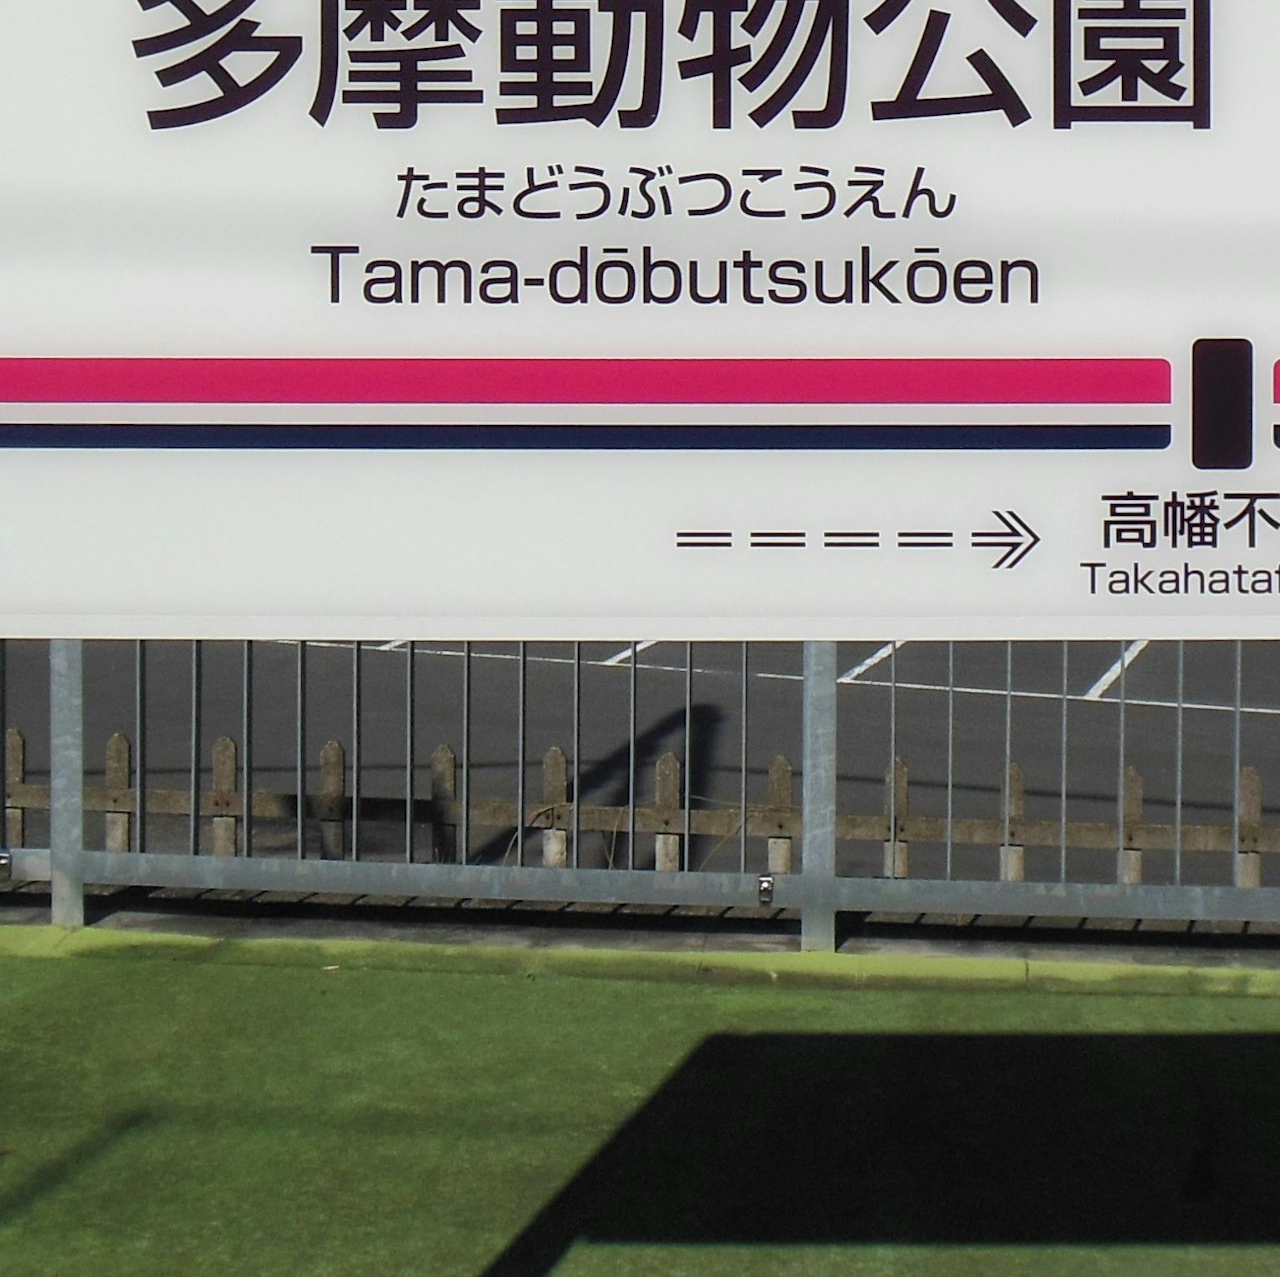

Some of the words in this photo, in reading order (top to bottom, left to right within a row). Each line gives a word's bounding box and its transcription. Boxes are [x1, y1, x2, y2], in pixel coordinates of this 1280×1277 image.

[396, 164, 957, 221] たまどうぶつこうえん
[310, 245, 1039, 305] Tama-dōbutsukōen
